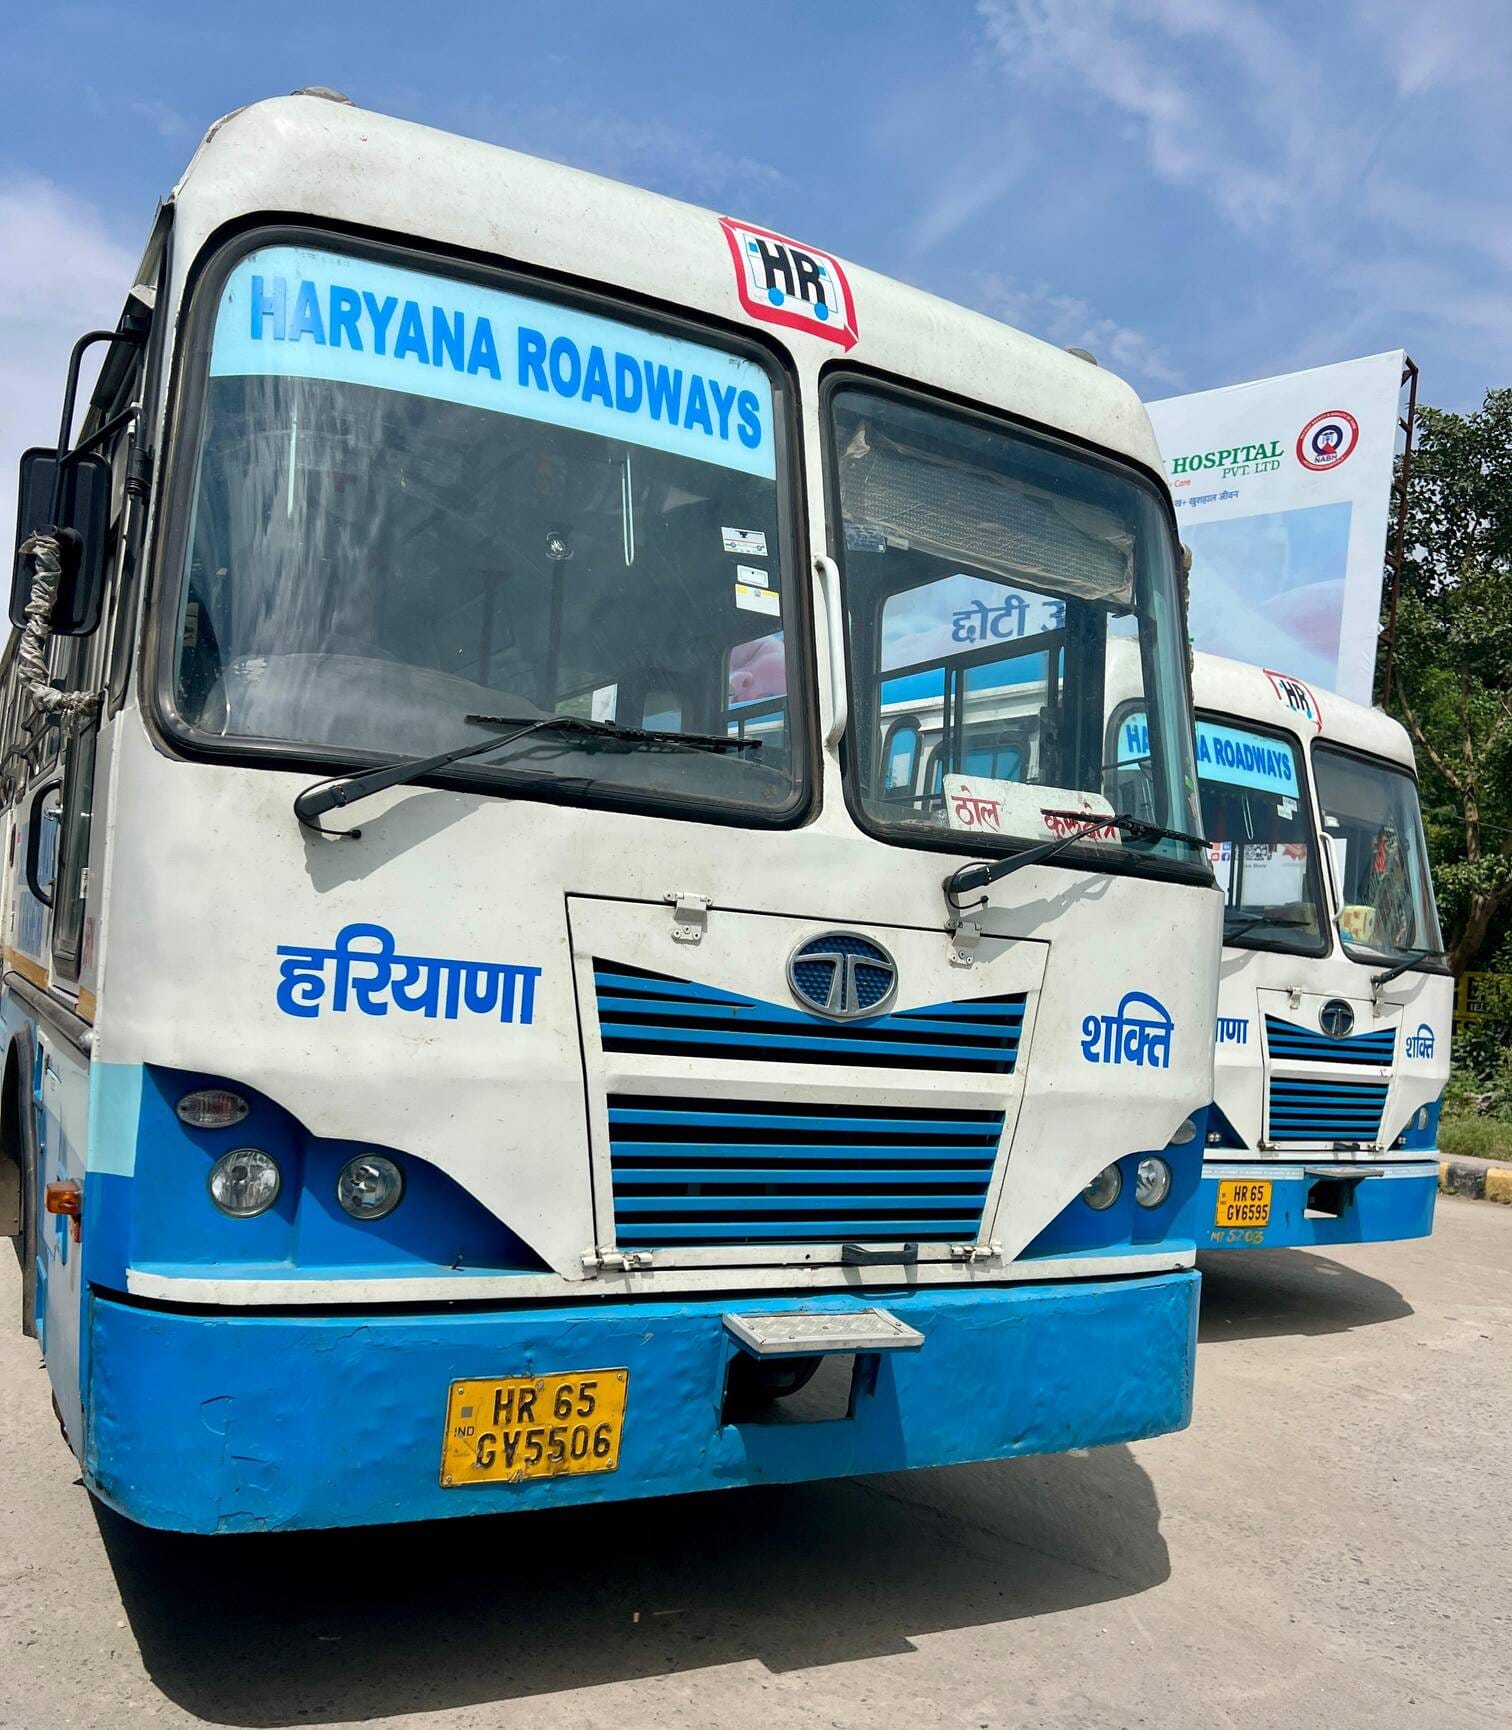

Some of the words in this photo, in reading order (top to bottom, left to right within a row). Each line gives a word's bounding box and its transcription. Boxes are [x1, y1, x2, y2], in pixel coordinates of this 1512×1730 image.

[756, 238, 827, 305] HR
[250, 275, 501, 380] HARYANA
[517, 326, 762, 449] ROADWAYS
[1171, 440, 1284, 474] HOSPITAL
[1254, 460, 1281, 474] LTD
[952, 594, 1030, 643] छोटी
[1281, 679, 1309, 712] HR
[1213, 736, 1292, 781] ROADWAYS
[275, 922, 542, 1025] हरियाणा
[1081, 991, 1174, 1068] शक्ति
[1406, 1023, 1434, 1059] शक्ति
[1233, 1185, 1248, 1202] HR
[1250, 1185, 1264, 1201] 65
[492, 1386, 539, 1425] HR
[553, 1380, 598, 1420] 65
[454, 1425, 475, 1437] IND
